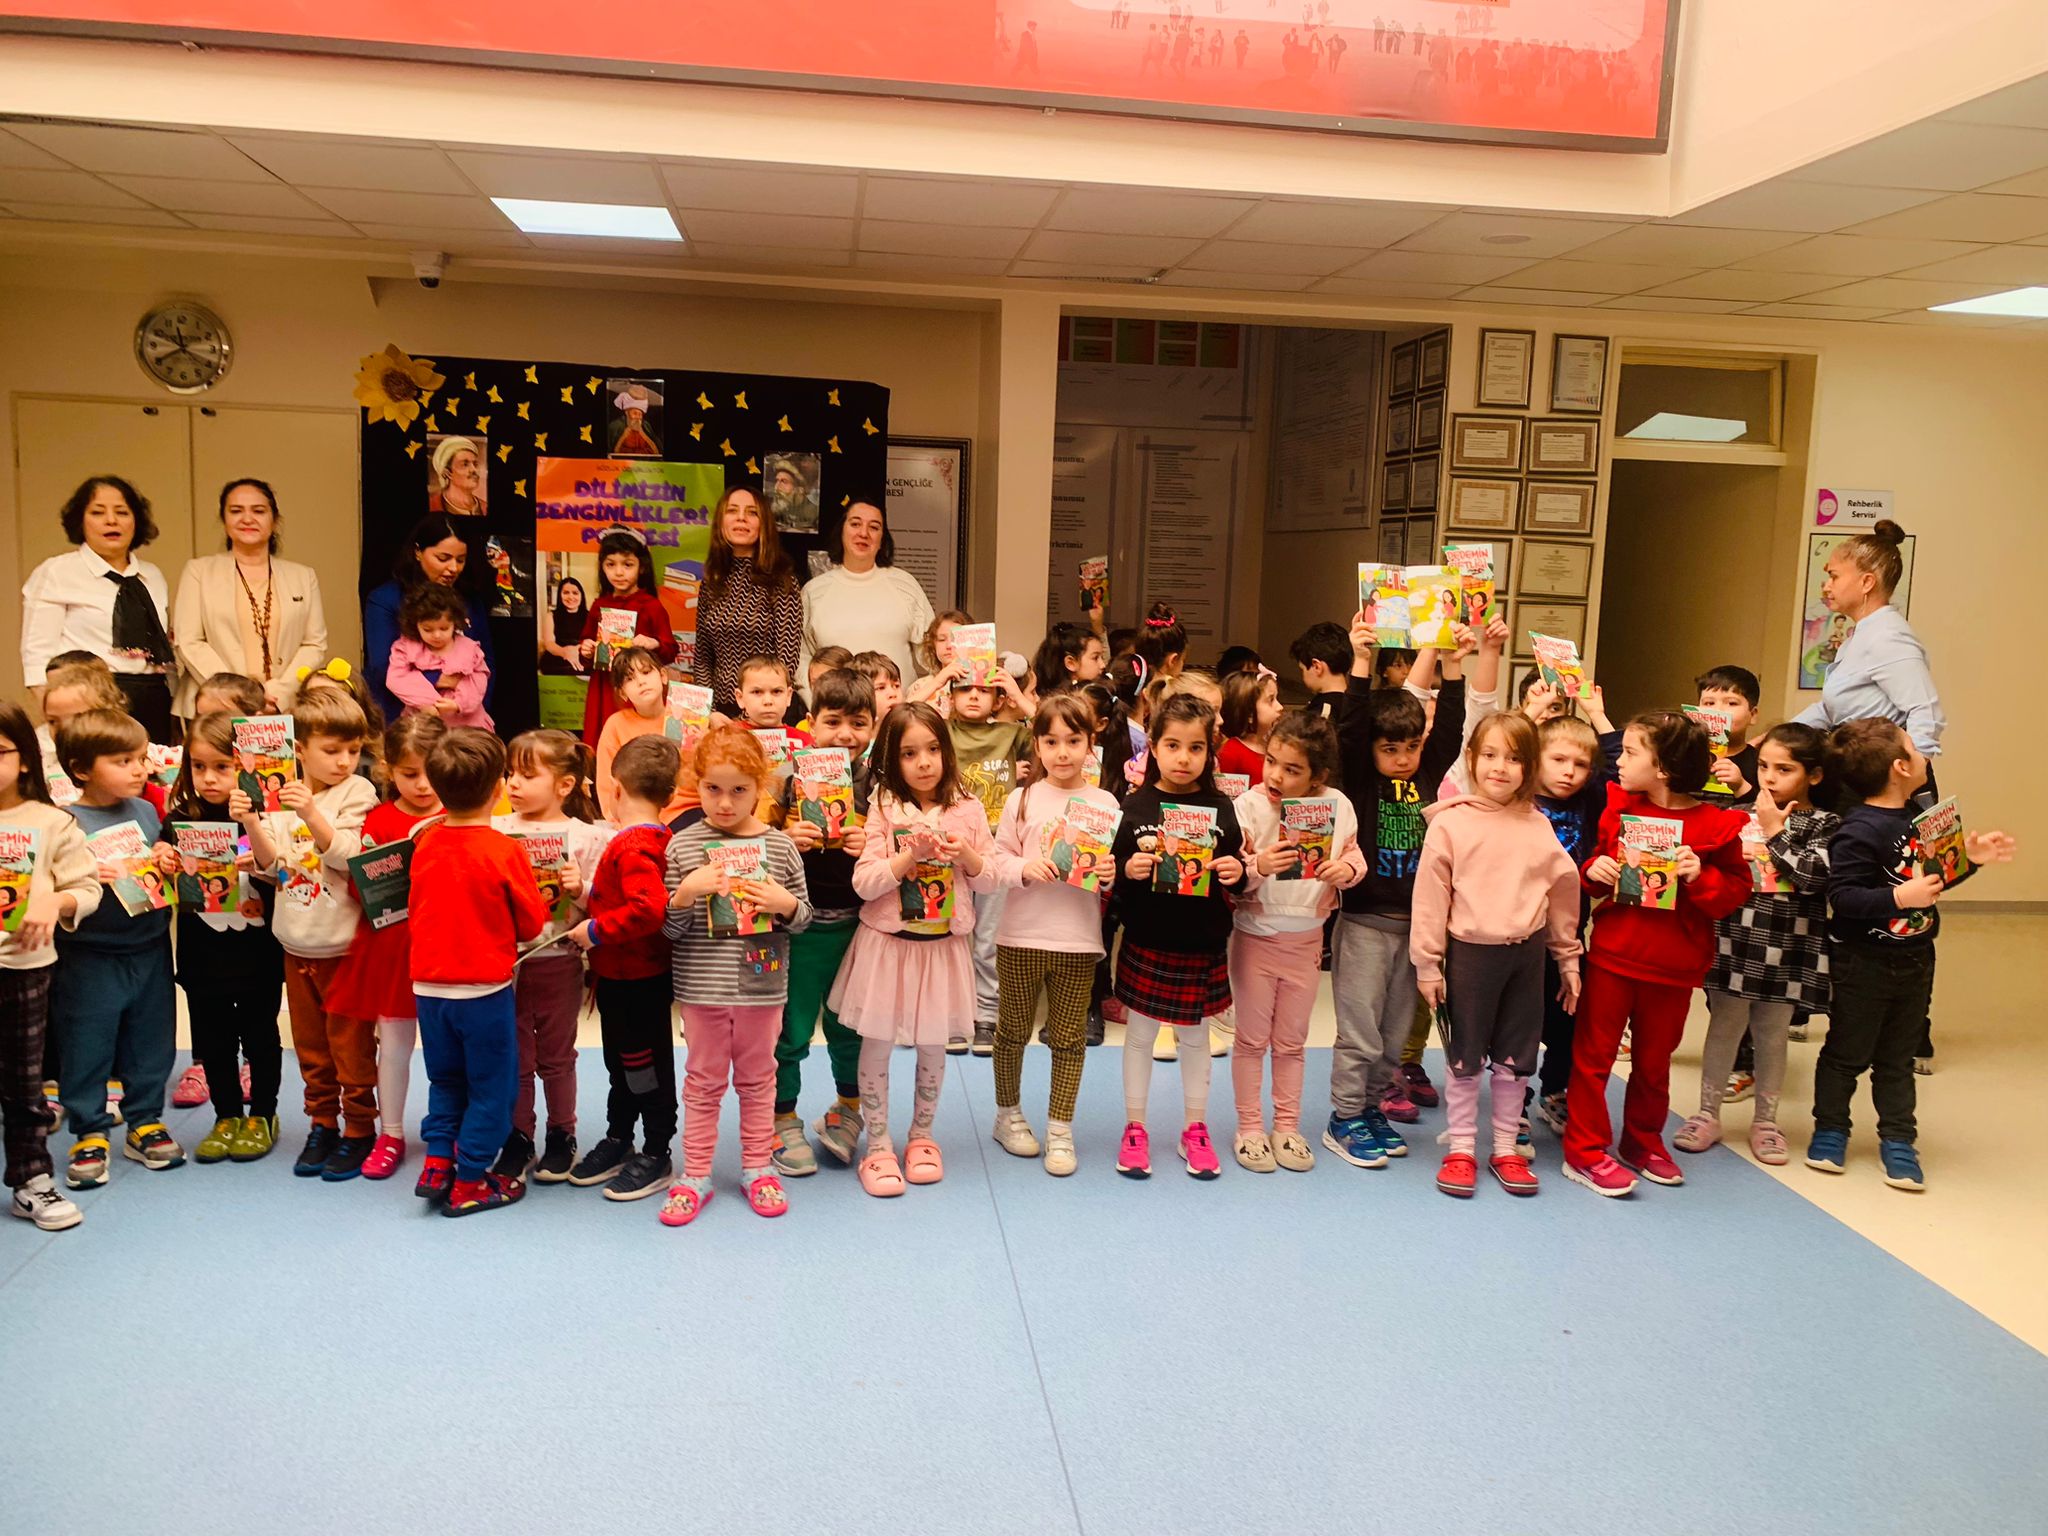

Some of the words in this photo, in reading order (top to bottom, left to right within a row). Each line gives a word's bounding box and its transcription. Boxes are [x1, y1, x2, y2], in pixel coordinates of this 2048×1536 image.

[574, 477, 686, 502] DİLİMİZİN
[892, 478, 934, 488] GENÇLİĞE
[1847, 499, 1883, 508] Rehberlik
[1851, 510, 1877, 519] Servisi
[235, 719, 287, 736] DEDEMİN
[236, 733, 286, 749] ÇİFTLİĞİ
[796, 752, 845, 768] DEDEMİN
[1165, 809, 1212, 823] DEDEMİN
[1285, 802, 1333, 815] DEDEMİN
[177, 826, 232, 841] DEDEMİN
[1624, 821, 1677, 836] DEDEMİN
[0, 830, 32, 846] EMİN
[177, 838, 230, 852] ÇİFTLİĞİ
[709, 844, 761, 859] DEDEMİN
